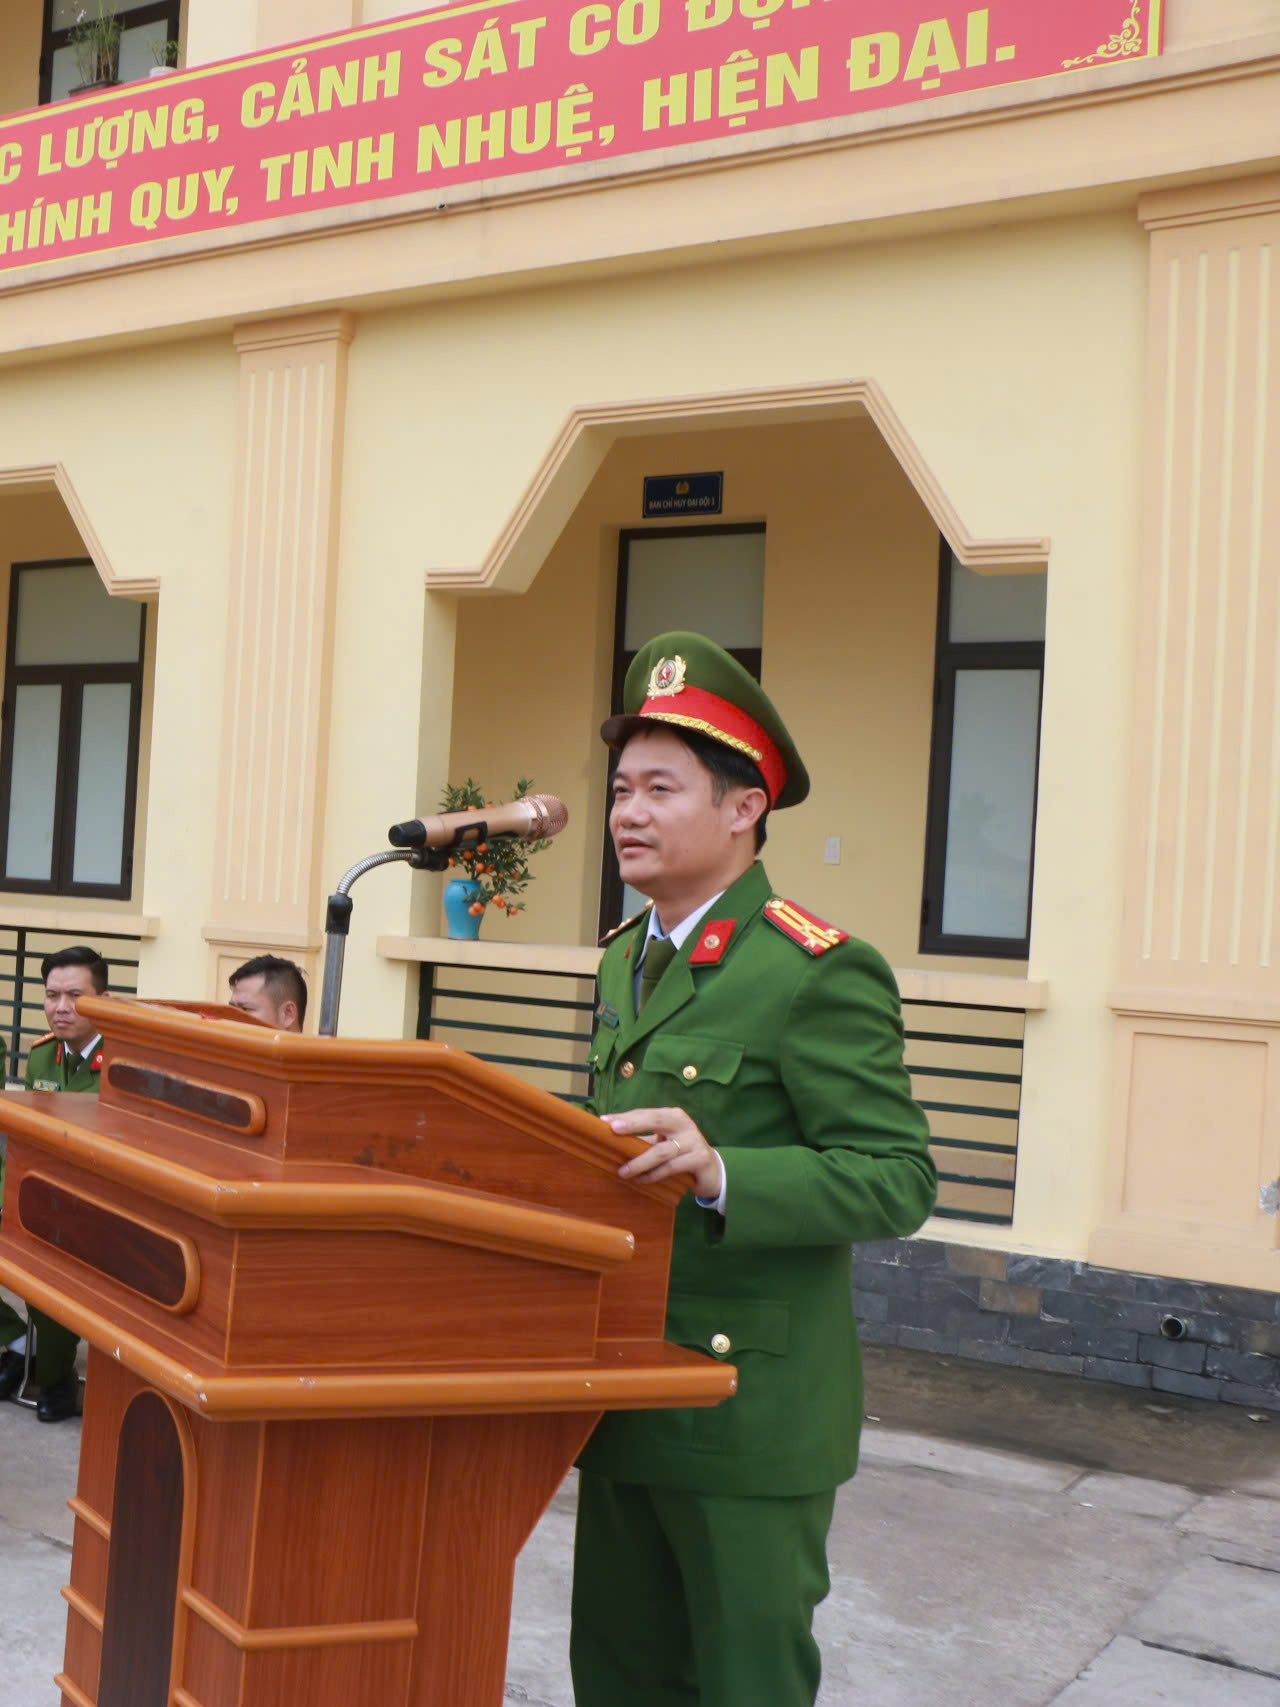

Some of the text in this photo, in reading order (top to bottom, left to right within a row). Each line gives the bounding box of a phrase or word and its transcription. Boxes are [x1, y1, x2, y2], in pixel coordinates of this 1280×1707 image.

[38, 97, 220, 176] LƯỢNG,
[240, 50, 402, 128] CẢNH
[423, 16, 547, 87] SÁT
[130, 166, 239, 230] QUY,
[260, 133, 395, 201] TINH
[416, 83, 615, 173] NHUỆ,
[643, 45, 819, 131] HIỆN
[846, 8, 1016, 91] ĐẠI.
